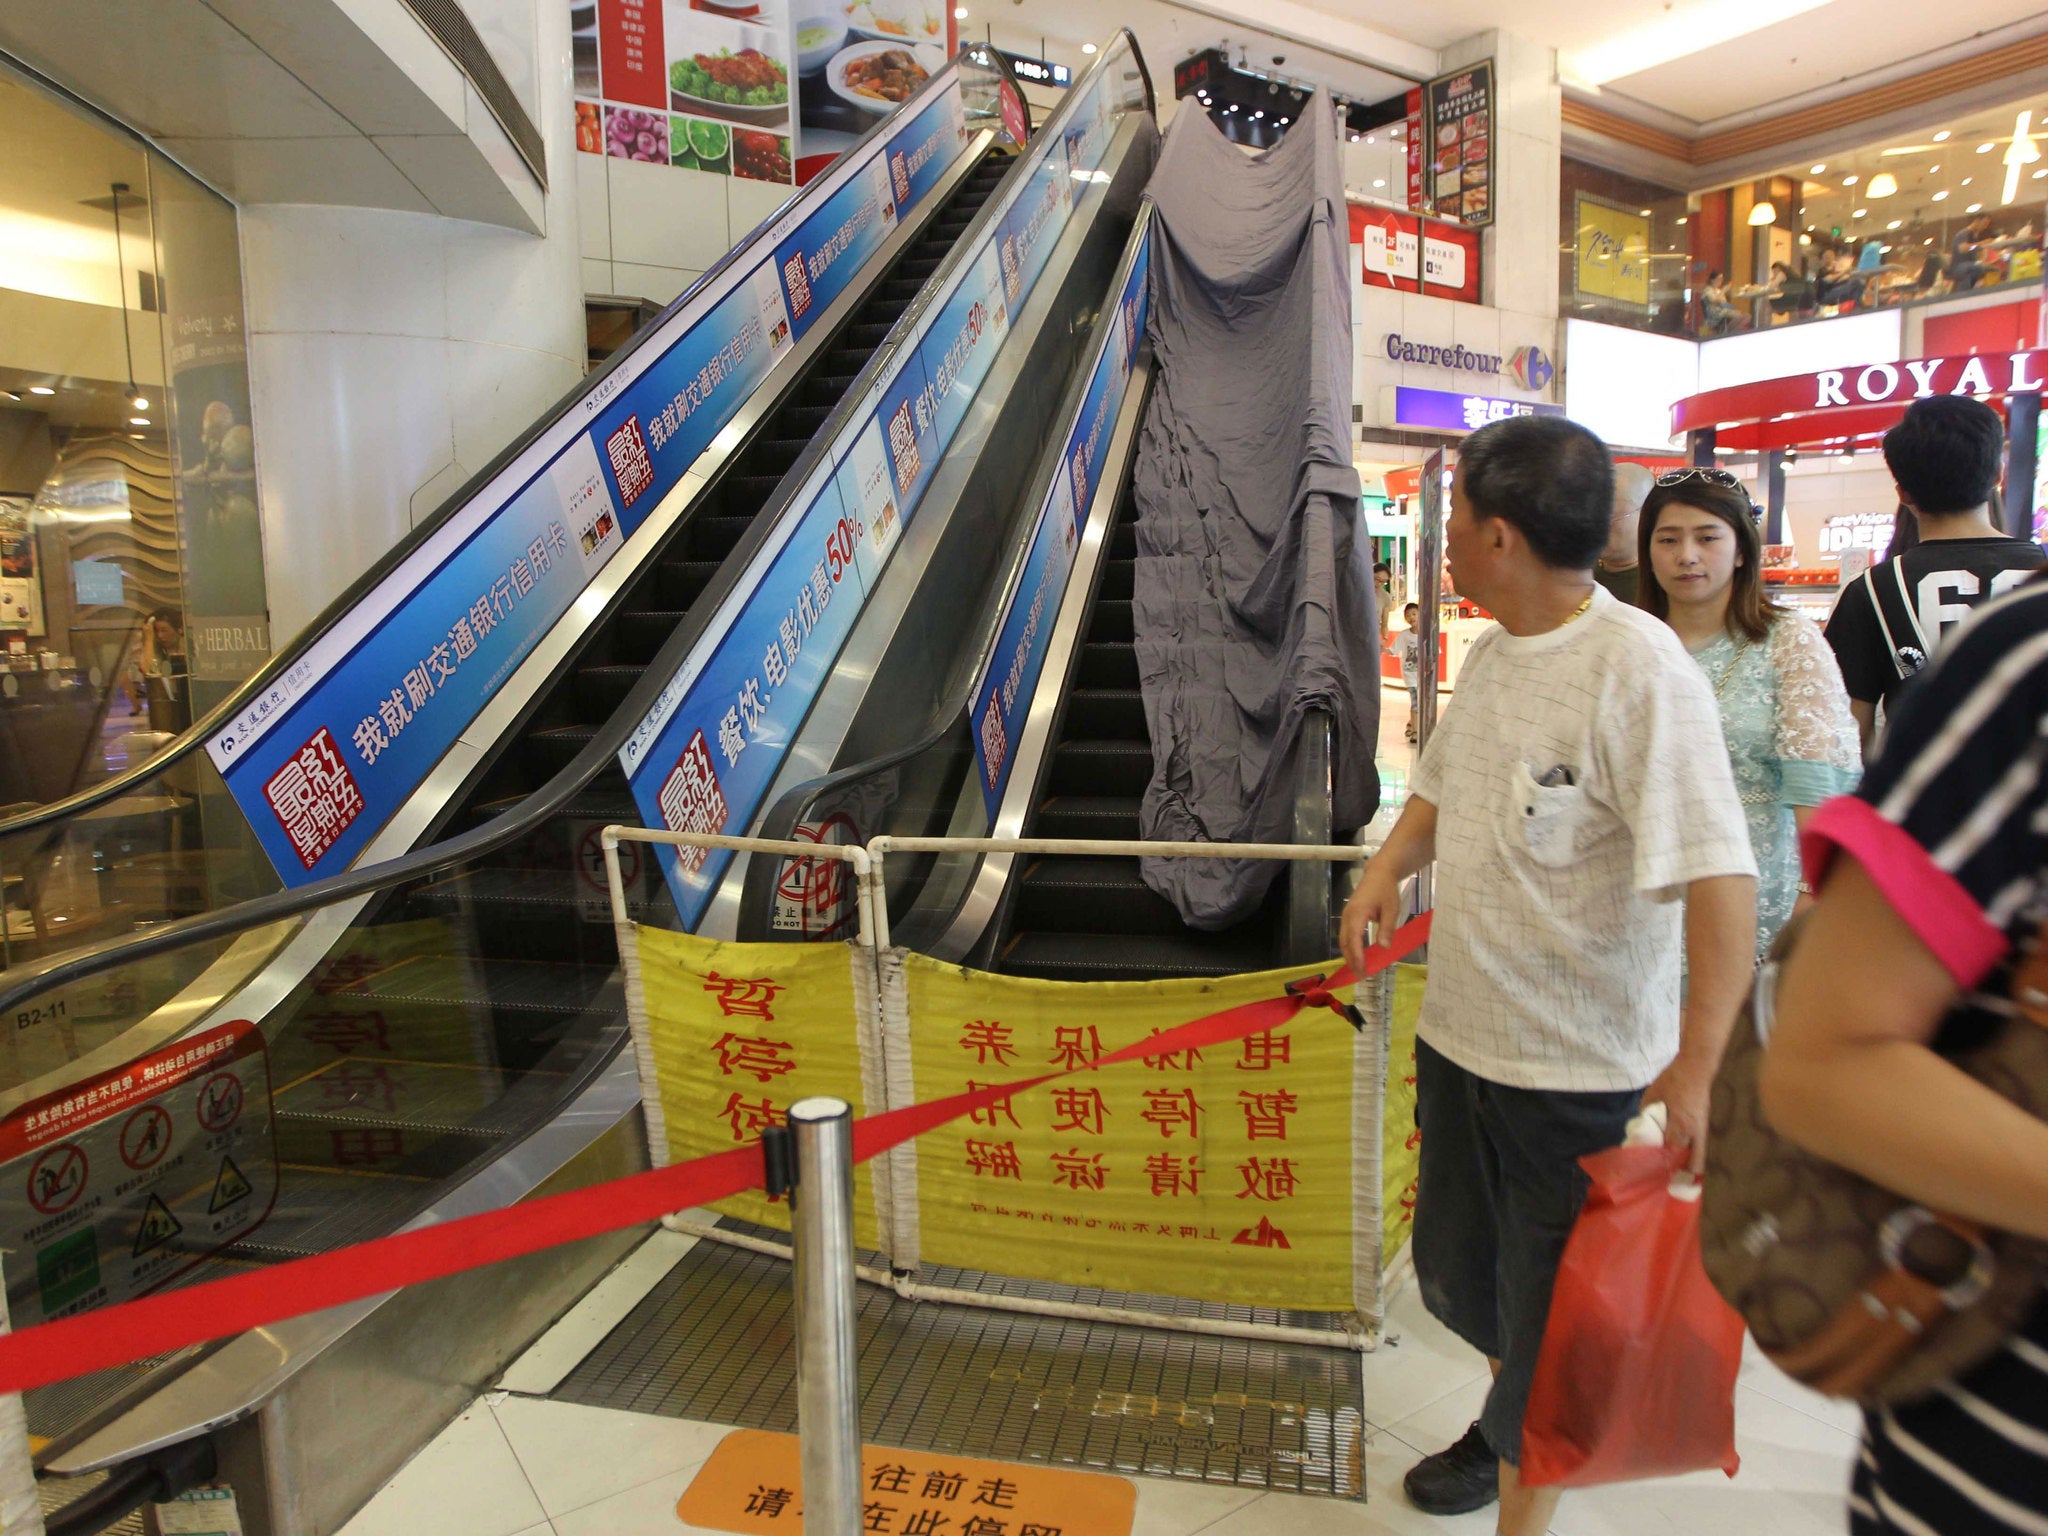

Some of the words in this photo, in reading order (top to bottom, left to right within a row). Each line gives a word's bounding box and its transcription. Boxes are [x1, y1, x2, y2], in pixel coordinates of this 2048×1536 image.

[1386, 333, 1503, 374] Carrefour
[649, 315, 764, 451] 我就刷交通银行信用卡
[1815, 353, 2044, 408] ROYAL
[205, 627, 268, 651] HERBAL
[351, 520, 568, 766] 我就刷交通银行信用卡
[305, 800, 365, 867] 交通银行信用卡
[784, 920, 800, 928] NOT
[17, 1001, 66, 1030] B2-11
